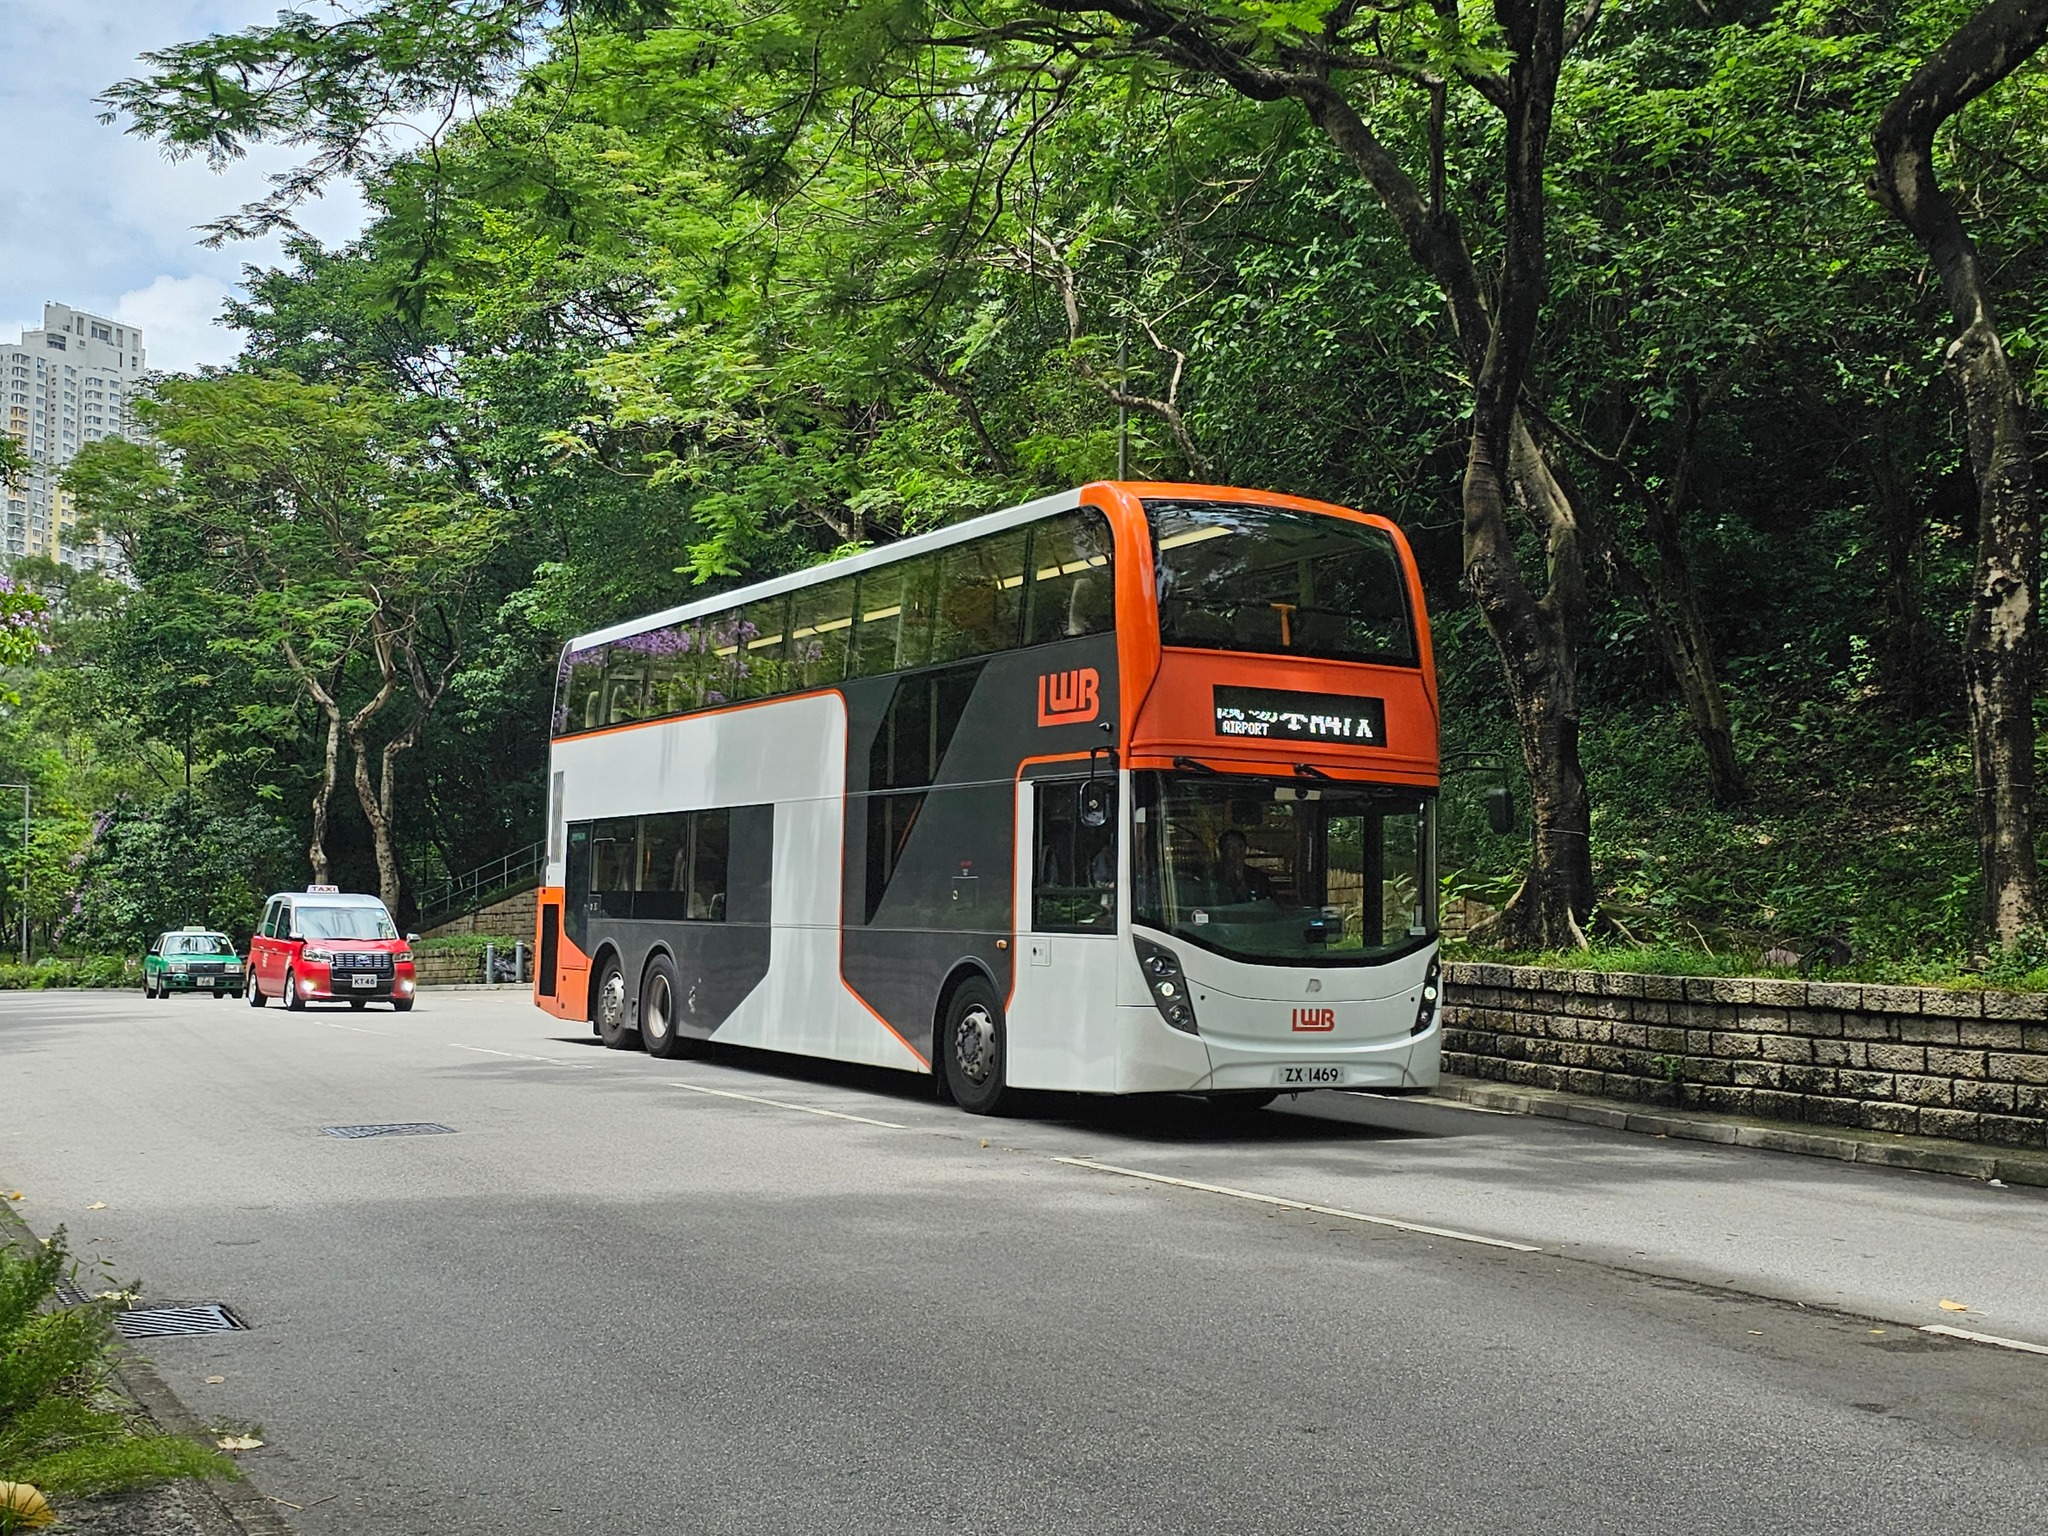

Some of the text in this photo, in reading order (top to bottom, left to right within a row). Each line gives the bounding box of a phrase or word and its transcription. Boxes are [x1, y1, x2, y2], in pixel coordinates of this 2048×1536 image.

[1038, 667, 1100, 728] LWB
[1222, 720, 1270, 736] AIRPORT
[1292, 1008, 1335, 1032] LWB
[1285, 1067, 1339, 1082] ZX 1469
